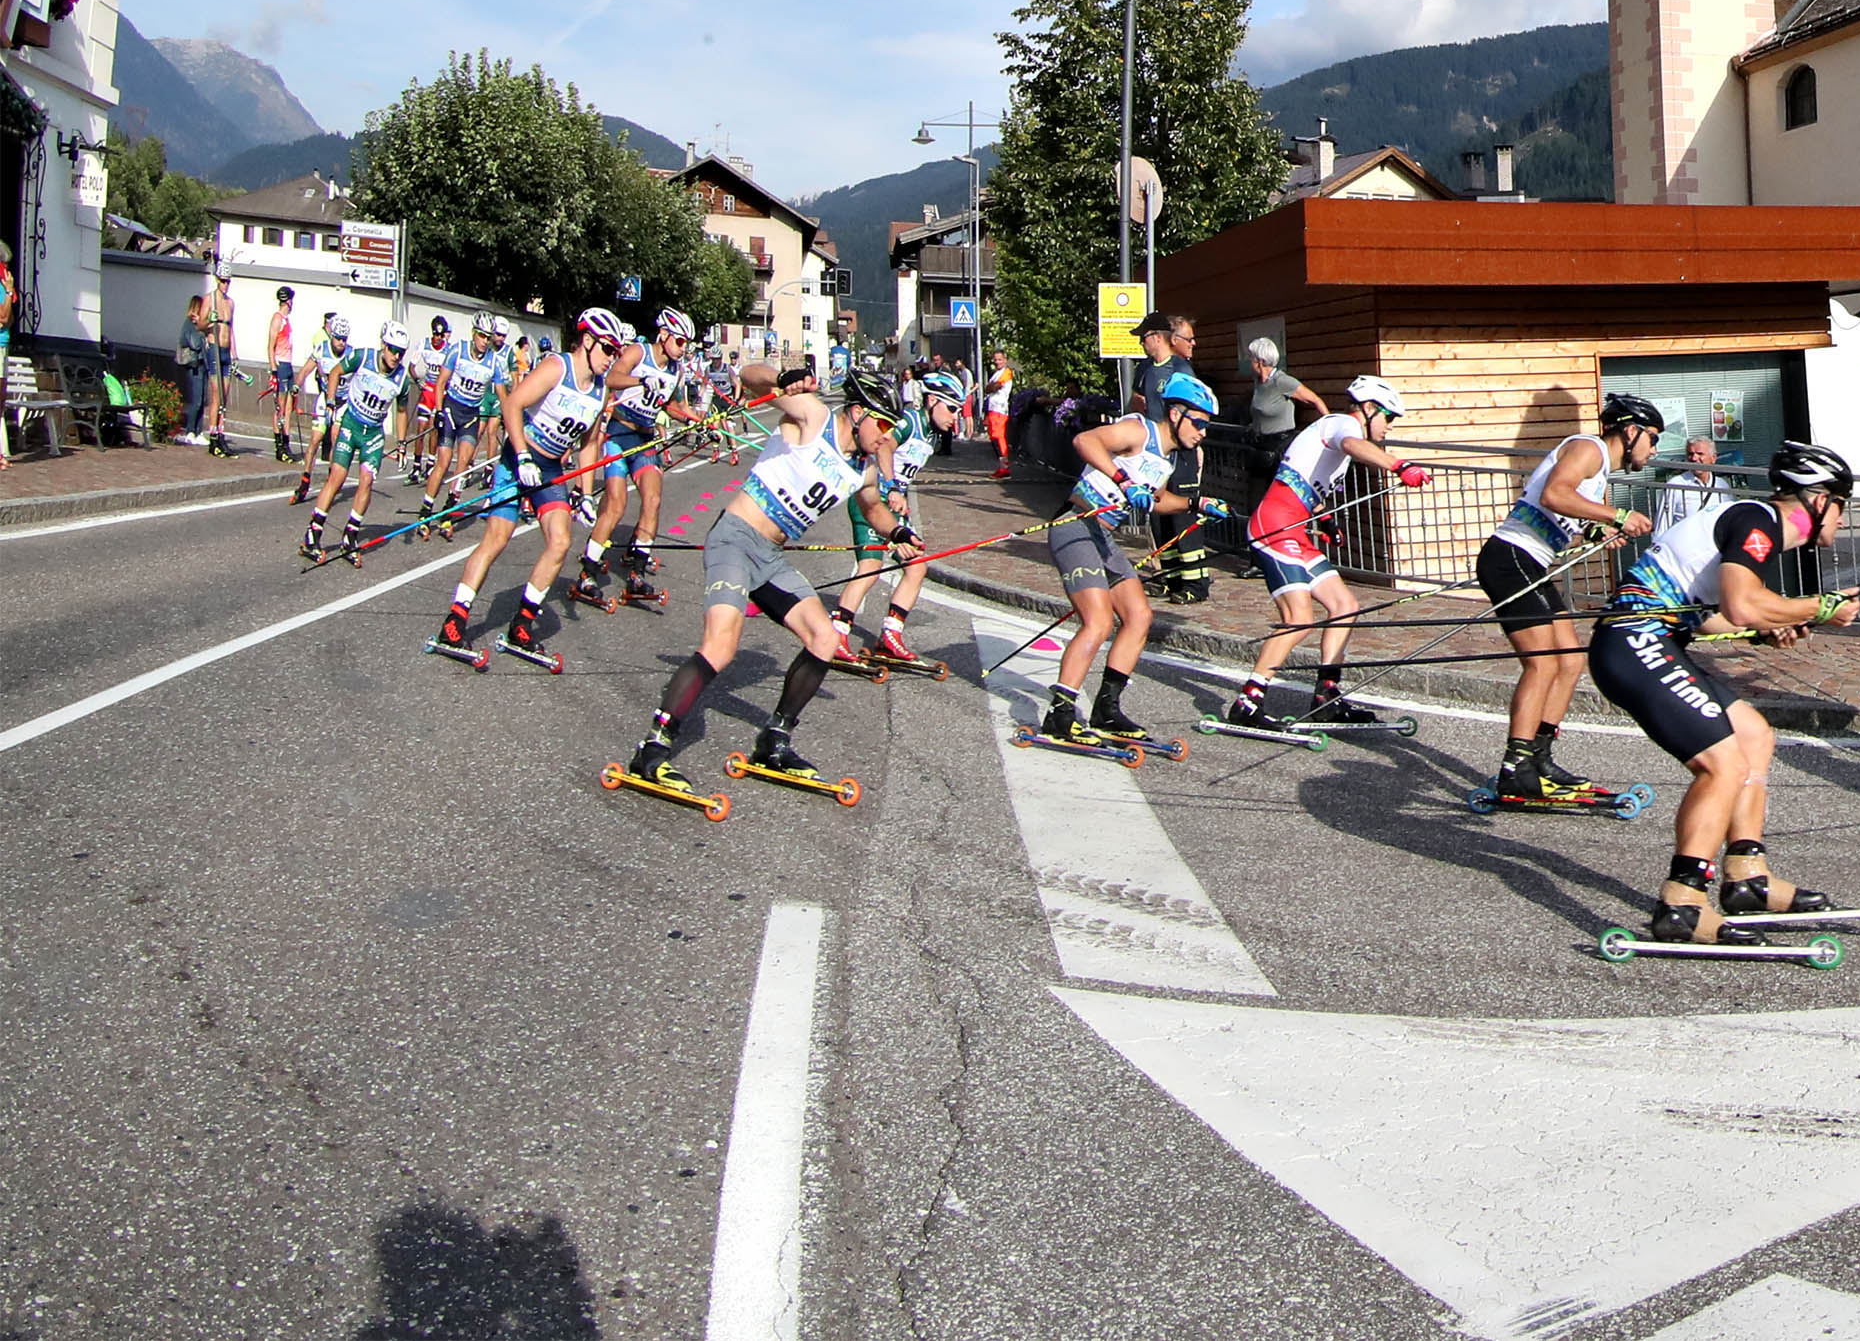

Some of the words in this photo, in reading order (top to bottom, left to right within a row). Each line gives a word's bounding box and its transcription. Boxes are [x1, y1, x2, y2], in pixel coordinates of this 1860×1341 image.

[460, 376, 483, 393] 102
[361, 390, 387, 410] 101
[557, 416, 588, 439] 98
[802, 481, 840, 517] 94
[1627, 631, 1676, 671] Ski
[1659, 664, 1723, 719] Time
